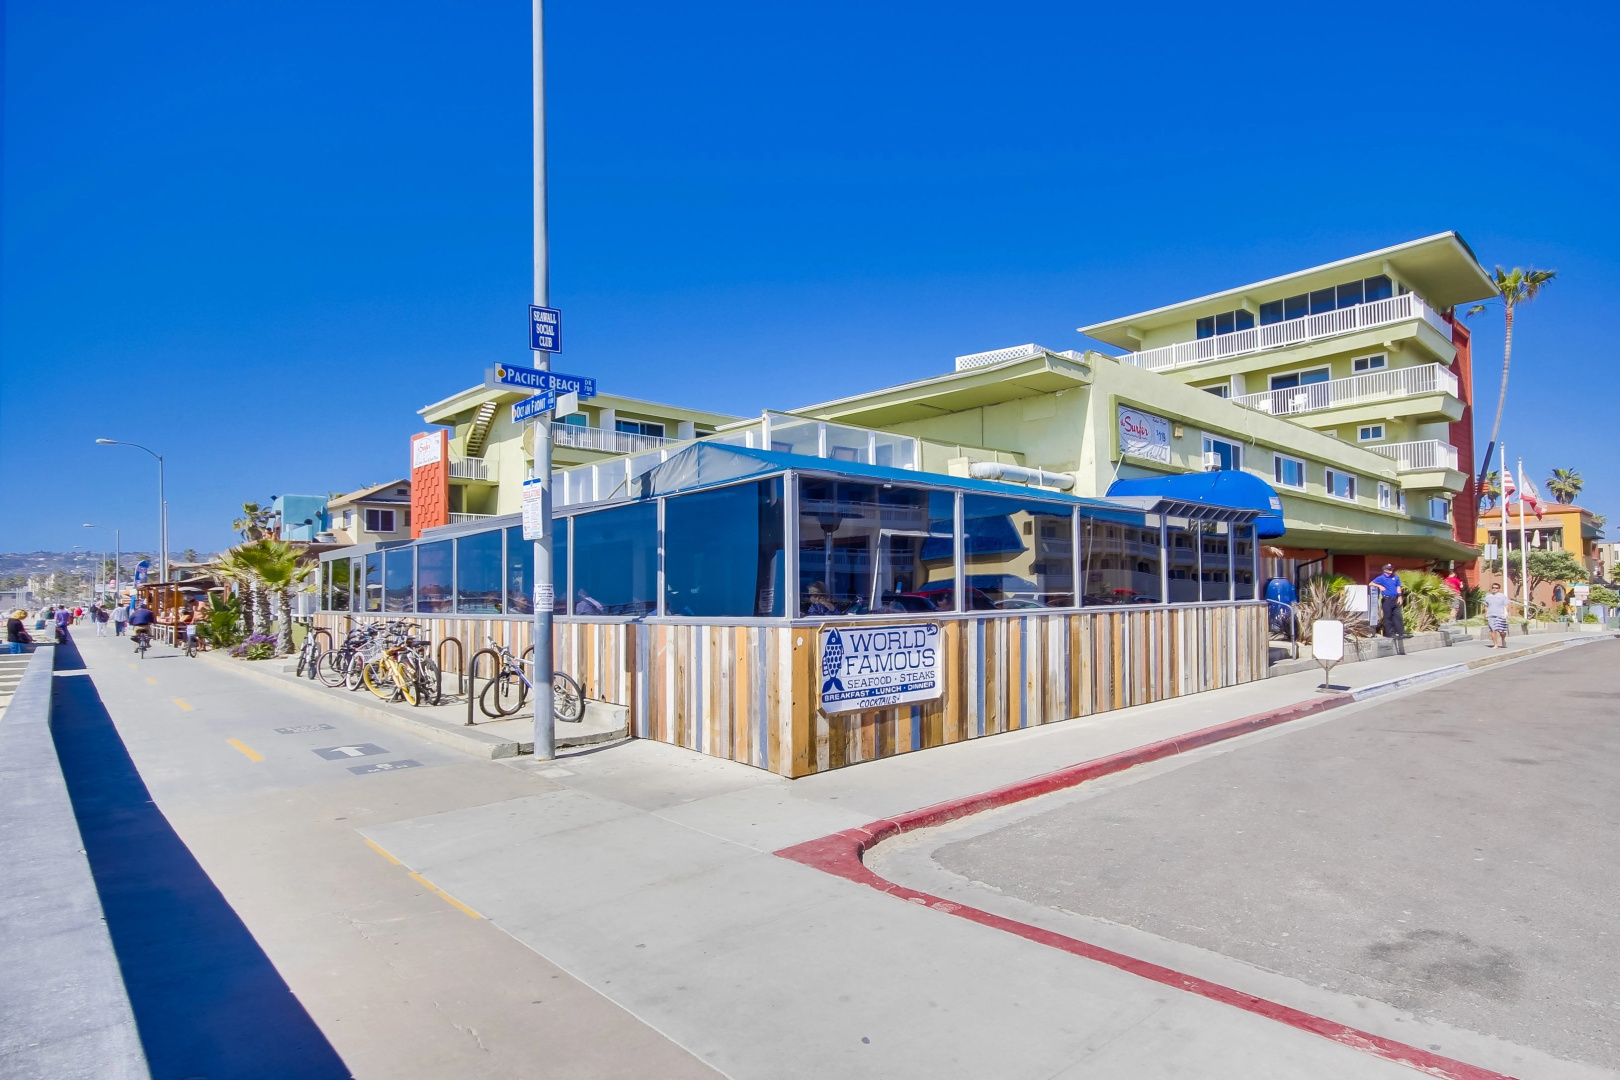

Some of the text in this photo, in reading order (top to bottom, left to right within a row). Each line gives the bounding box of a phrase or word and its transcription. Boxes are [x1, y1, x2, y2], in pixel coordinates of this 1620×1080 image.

[533, 310, 557, 324] SEAWALL
[536, 323, 555, 336] SOCIAL
[539, 336, 553, 348] CLUB
[507, 368, 580, 392] PACIFIC BEACH
[531, 397, 546, 414] FRONT
[849, 629, 926, 653] WORLD
[845, 648, 936, 675] FAMOUS
[847, 670, 935, 690] SEAFOOD STEAKS
[824, 681, 934, 702] BREAKFAST LUNCH DINNER
[859, 695, 897, 708] COCKTAILS
